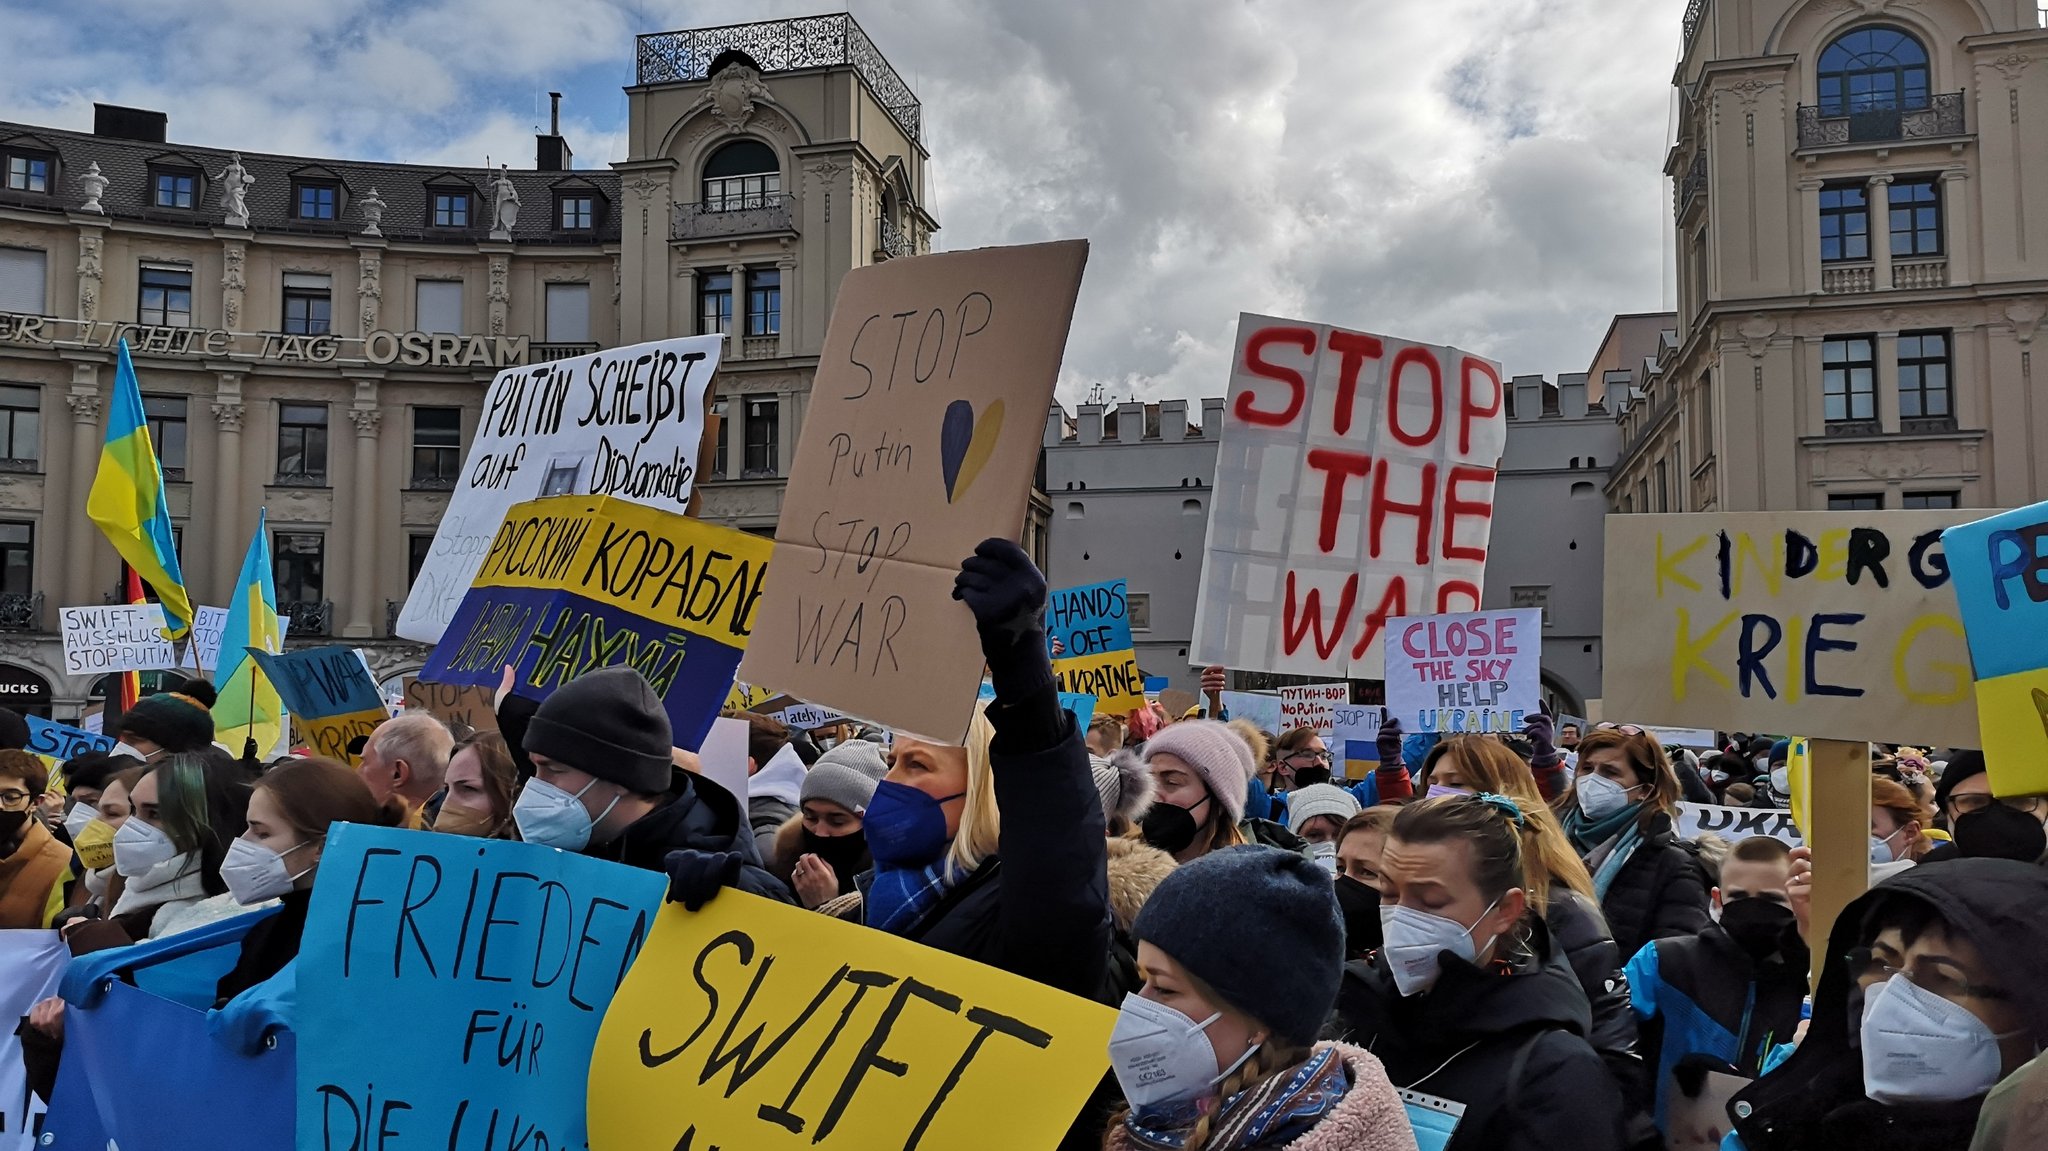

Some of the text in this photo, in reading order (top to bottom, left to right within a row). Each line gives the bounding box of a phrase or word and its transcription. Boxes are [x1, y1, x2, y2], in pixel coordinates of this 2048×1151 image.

[81, 319, 231, 357] LICHTE
[255, 331, 339, 363] TAG
[364, 329, 530, 368] OSRAM
[843, 291, 993, 401] STOP
[1234, 325, 1503, 455] STOP
[471, 434, 695, 504] auf Diplomatie
[828, 428, 912, 487] Putin
[1307, 448, 1497, 566] THE
[479, 507, 596, 582] РУССКИЙ
[808, 510, 911, 594] STOP
[795, 594, 907, 678] WAR
[1052, 582, 1126, 629] HANDS
[69, 647, 118, 671] STOP
[1070, 625, 1113, 656] OFF
[1402, 617, 1518, 659] CLOSE
[1412, 657, 1513, 683] THE SKY
[1670, 606, 1972, 705] KRIEG
[1057, 659, 1144, 703] UKRAINE
[1437, 680, 1509, 708] HELP
[1335, 709, 1365, 727] STOP
[462, 1002, 545, 1077] FÜR
[638, 928, 1054, 1151] SWIFT
